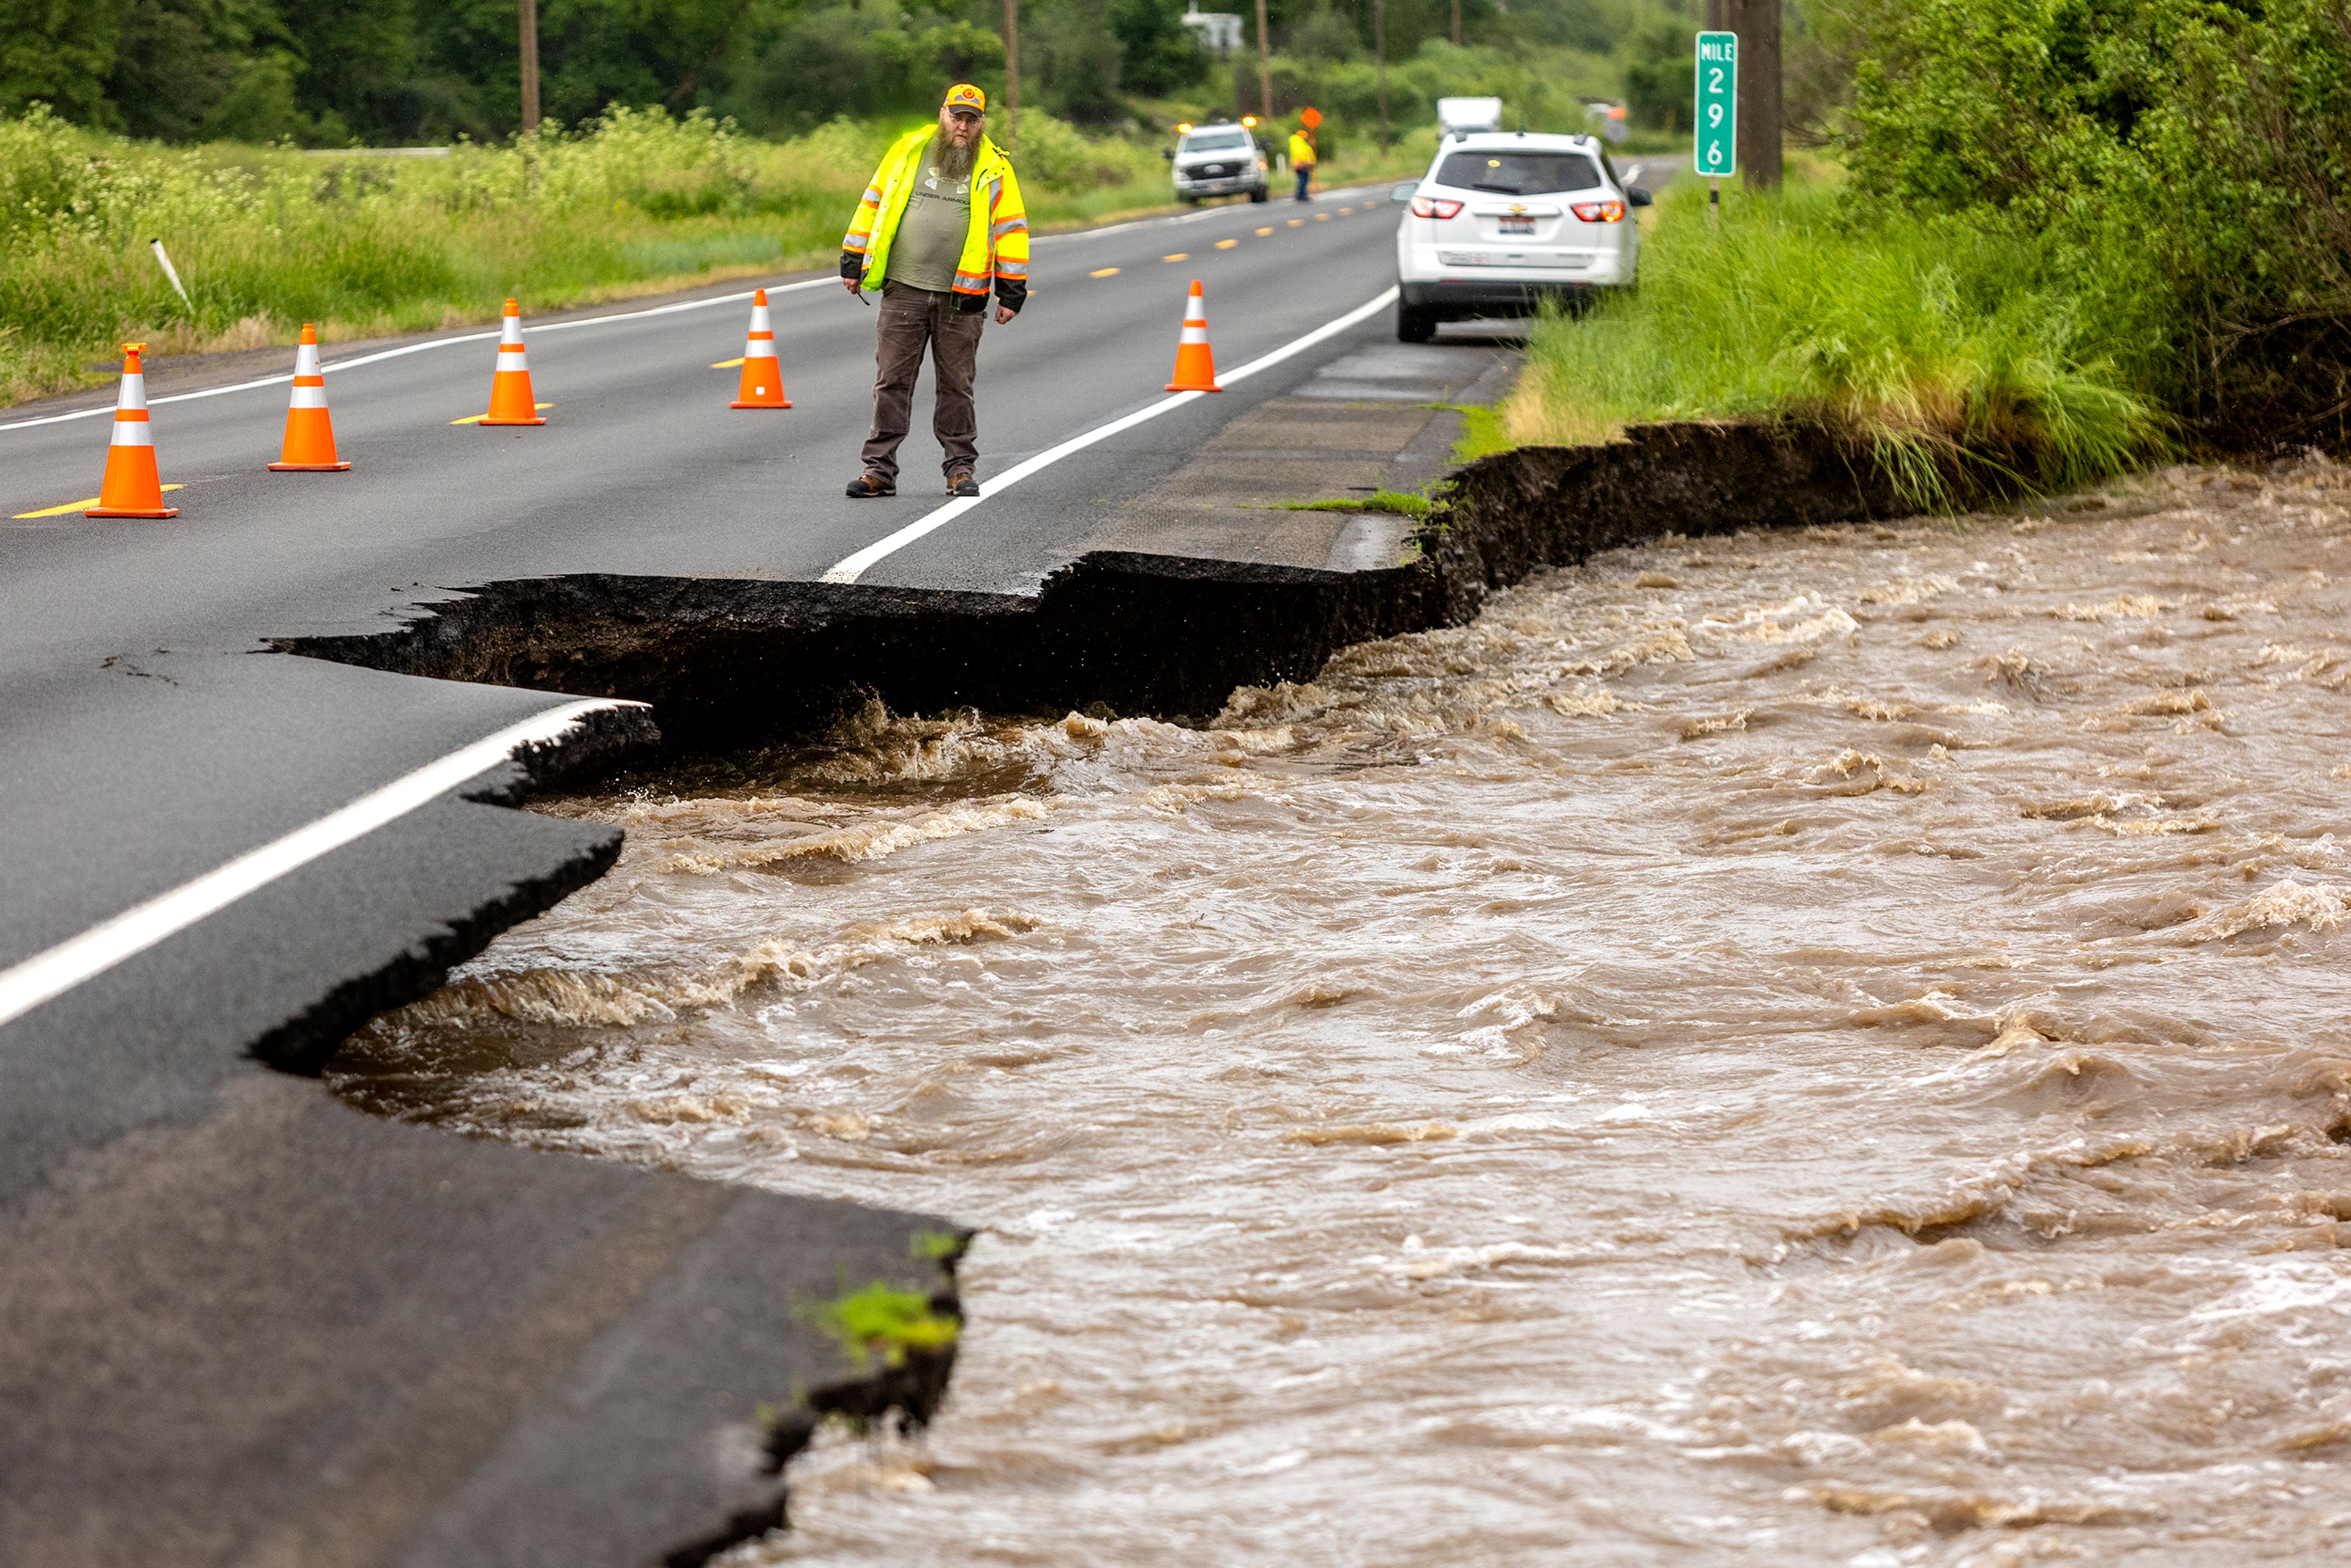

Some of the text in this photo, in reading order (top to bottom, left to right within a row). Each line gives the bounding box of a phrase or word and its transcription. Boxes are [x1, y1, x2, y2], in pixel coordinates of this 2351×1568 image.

[1701, 43, 1733, 61] MILE
[1707, 67, 1723, 165] 296
[915, 191, 970, 205] UNDER ARMOU
